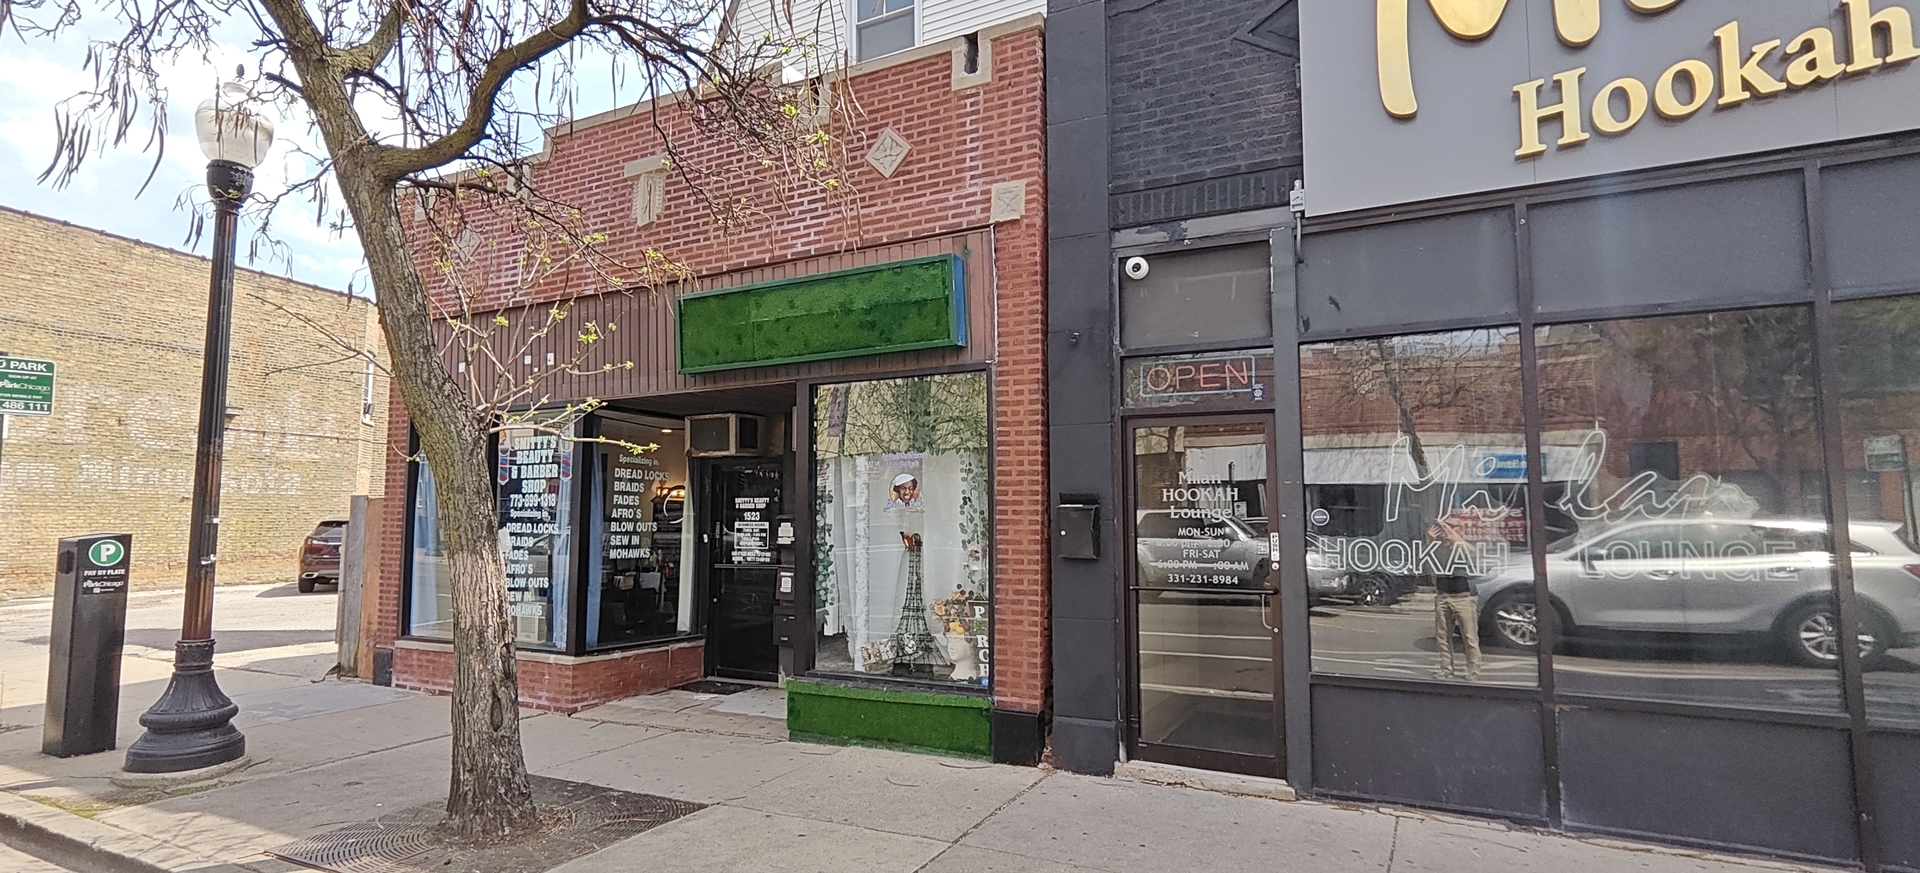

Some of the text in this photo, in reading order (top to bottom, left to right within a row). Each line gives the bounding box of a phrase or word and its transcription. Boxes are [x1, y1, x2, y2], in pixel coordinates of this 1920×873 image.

[1512, 1, 1920, 158] Hookah
[10, 361, 47, 371] PARK
[1147, 361, 1248, 391] OPEN
[2, 401, 48, 411] 486 111
[514, 435, 556, 450] SMITTY'S
[516, 450, 554, 464] BEAUTY
[619, 454, 652, 466] Specializing
[511, 464, 558, 479] & BARBER
[614, 468, 670, 481] DREAD LOCKS
[1178, 472, 1221, 485] Milan
[521, 479, 546, 493] SHOP
[613, 481, 645, 493] BRAIDS
[613, 494, 640, 506] FADES
[1162, 488, 1239, 502] HOOKAH
[510, 509, 541, 519] Specializing
[611, 508, 642, 519] AFRO'S
[743, 512, 760, 521] 1523
[1170, 505, 1233, 523] Lounge
[506, 523, 559, 534] DREAD LOCKS
[610, 521, 658, 532] BLOW OUTS
[1178, 527, 1225, 537] MON-SUN
[506, 536, 533, 547] BRAIDS
[610, 535, 640, 546] SEW IN
[101, 544, 116, 562] P
[505, 550, 529, 560] FADES
[609, 548, 651, 559] MOHAWKS
[1183, 549, 1221, 559] FRI-SAT
[1319, 538, 1799, 582] HOOKAH LOUNGE
[107, 568, 125, 576] PLATE
[506, 563, 533, 574] AFRO'S
[506, 577, 549, 588] BLOW OUTS
[1167, 573, 1239, 585] 331-231-8984
[523, 591, 532, 602] IN
[509, 605, 542, 616] OHAWKS
